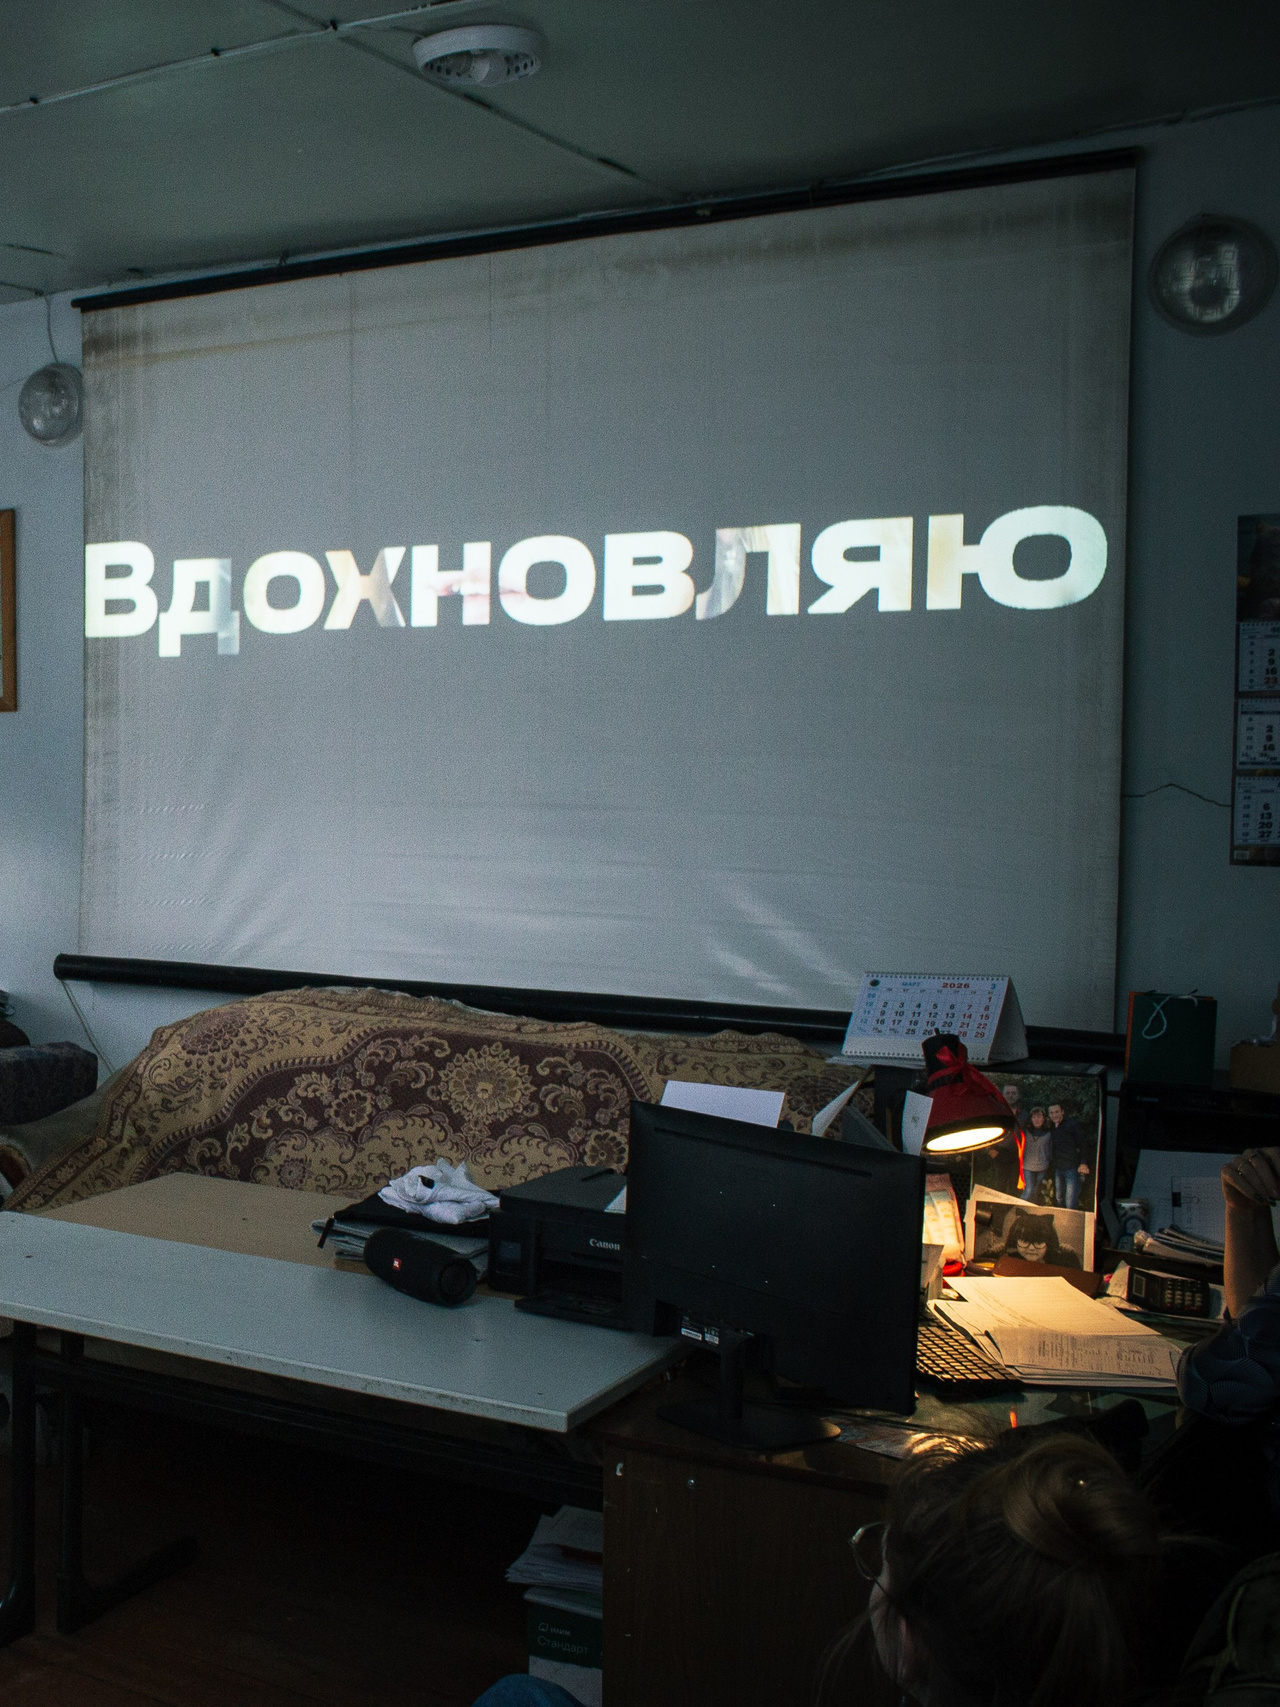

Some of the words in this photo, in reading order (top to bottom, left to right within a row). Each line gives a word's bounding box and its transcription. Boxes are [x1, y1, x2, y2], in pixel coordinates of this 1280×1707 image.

[1259, 821, 1273, 829] 20
[588, 1237, 621, 1251] Canon
[537, 1635, 588, 1655] Стандарт
